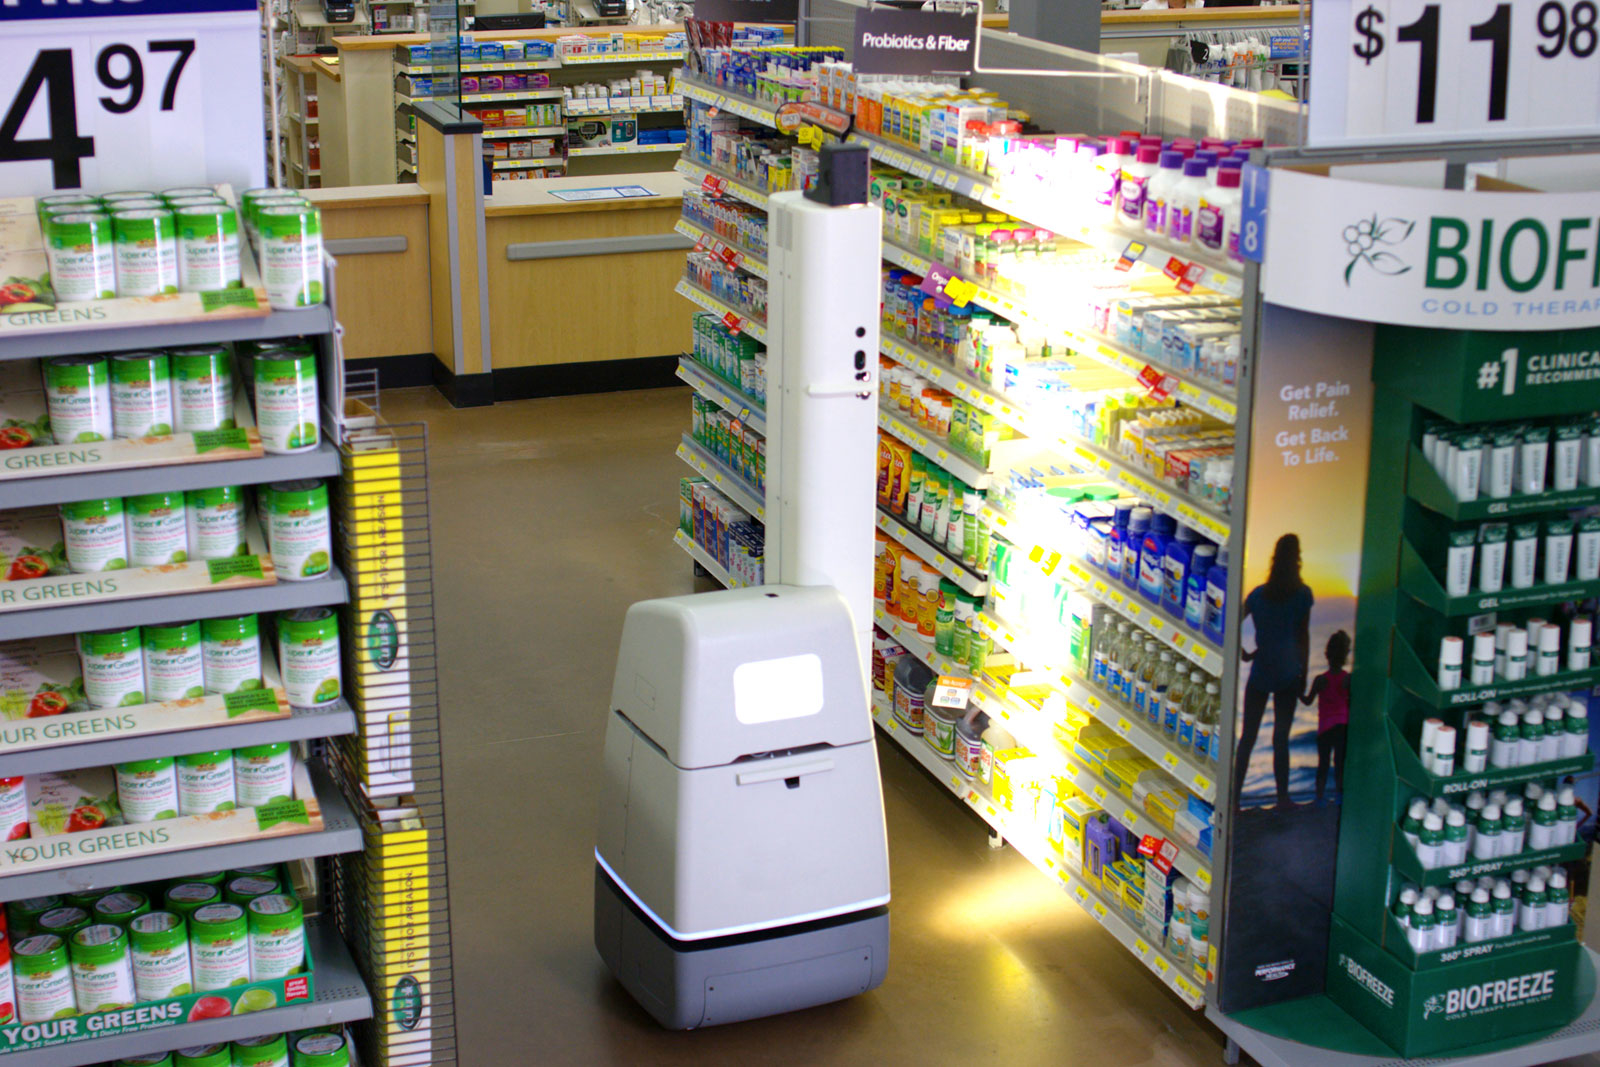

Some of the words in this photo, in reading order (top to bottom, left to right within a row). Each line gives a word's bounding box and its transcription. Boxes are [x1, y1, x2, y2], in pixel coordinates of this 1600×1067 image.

[863, 32, 924, 49] Probiotics
[926, 34, 936, 49] &
[938, 36, 970, 51] Fiber
[1424, 215, 1600, 293] BIOF
[8, 306, 107, 326] GREENS
[1421, 298, 1498, 316] COLD
[1477, 348, 1519, 397] #1
[1279, 384, 1311, 401] Get
[1315, 381, 1350, 398] Pain
[1288, 401, 1340, 421] Relief.
[1275, 431, 1307, 448] Get
[1310, 425, 1349, 444] Back
[4, 449, 102, 470] GREENS
[1282, 451, 1302, 467] To
[1305, 447, 1340, 465] Life.
[1487, 502, 1510, 514] GEL
[22, 577, 118, 602] GREENS
[1478, 597, 1500, 609] GEL
[1451, 689, 1497, 704] ROLL-ON
[42, 714, 137, 739] GREENS
[1443, 778, 1488, 793] ROLL-ON
[5, 842, 73, 865] YOUR
[78, 827, 169, 854] GREENS
[1472, 862, 1504, 875] SPRAY
[1463, 943, 1494, 957] SPRAY
[1255, 962, 1296, 976] PERFORMANCE
[1347, 957, 1395, 1006] BIOFREEZE
[1446, 969, 1556, 1014] BIOFREEZE
[1444, 1012, 1467, 1021] COLD
[1469, 1004, 1504, 1016] THERAPY
[2, 1019, 78, 1045] YOUR
[86, 1002, 182, 1031] GREENS
[67, 1033, 91, 1042] Foods
[140, 1019, 176, 1030] Probiotics
